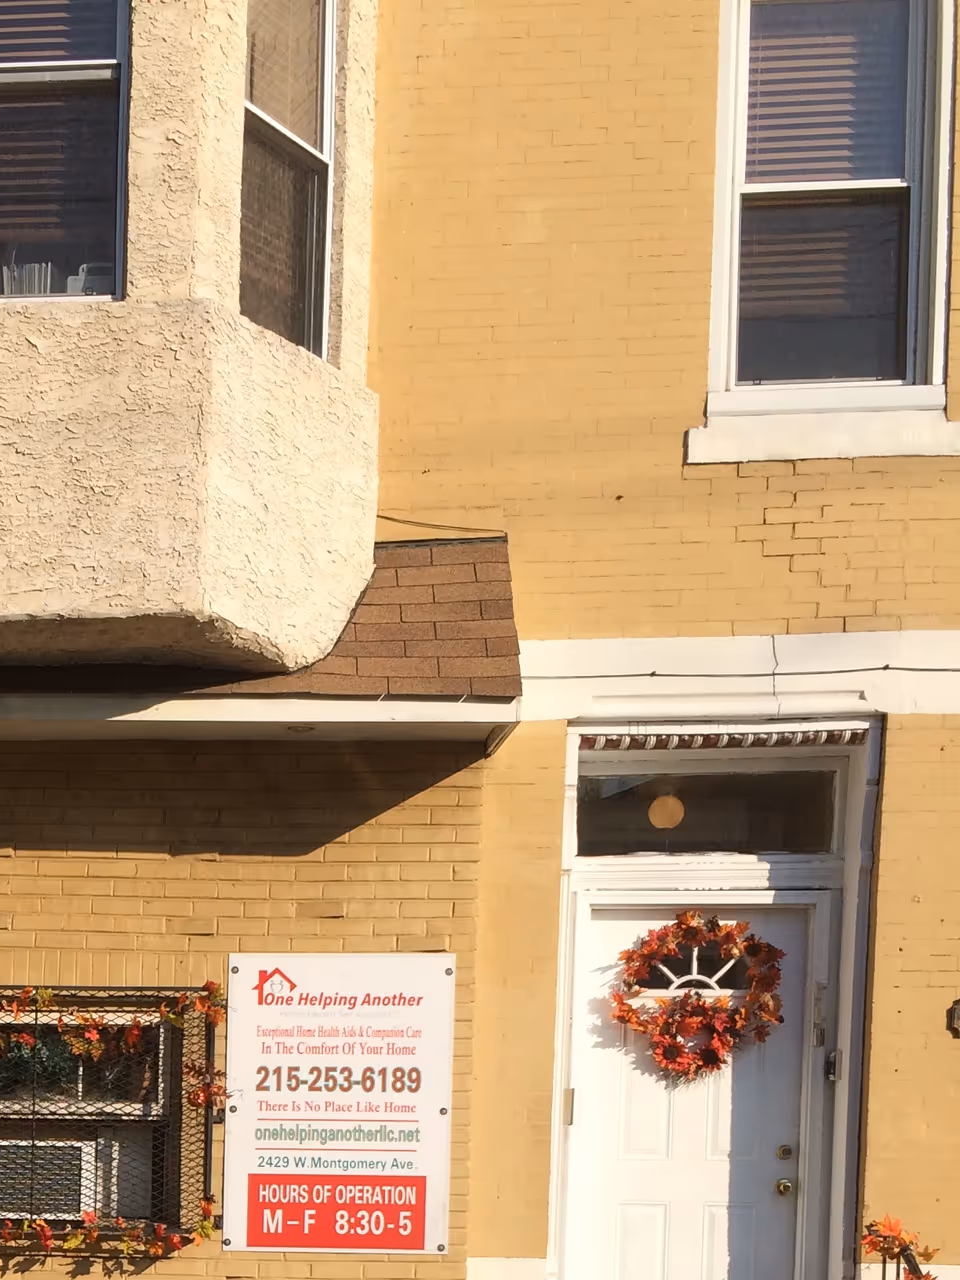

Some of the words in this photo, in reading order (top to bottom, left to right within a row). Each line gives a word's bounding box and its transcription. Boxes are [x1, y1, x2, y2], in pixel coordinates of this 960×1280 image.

[264, 992, 294, 1006] One
[298, 992, 357, 1009] Helping
[360, 992, 423, 1007] Another
[256, 1025, 295, 1040] Exceptional
[296, 1026, 316, 1038] Home
[318, 1026, 340, 1038] Health
[341, 1026, 357, 1038] Aids
[358, 1026, 364, 1038] &
[365, 1026, 404, 1040] Companion
[405, 1026, 423, 1038] Care
[261, 1042, 272, 1054] In
[275, 1042, 294, 1055] The
[296, 1042, 339, 1055] Comfort
[342, 1042, 356, 1055] Of
[359, 1042, 384, 1055] Your
[386, 1043, 417, 1056] Home
[255, 1065, 422, 1093] 215-253-6189
[257, 1100, 288, 1112] There
[292, 1100, 301, 1112] Is
[304, 1101, 321, 1112] No
[324, 1101, 353, 1113] Place
[356, 1101, 380, 1113] Like
[383, 1101, 417, 1113] Home
[255, 1124, 420, 1145] onehelpinganotherllc.net
[257, 1156, 289, 1168] 2429
[390, 1158, 419, 1170] Ave.
[258, 1184, 309, 1203] HOURS
[312, 1184, 332, 1203] OF
[335, 1185, 417, 1205] OPERATION
